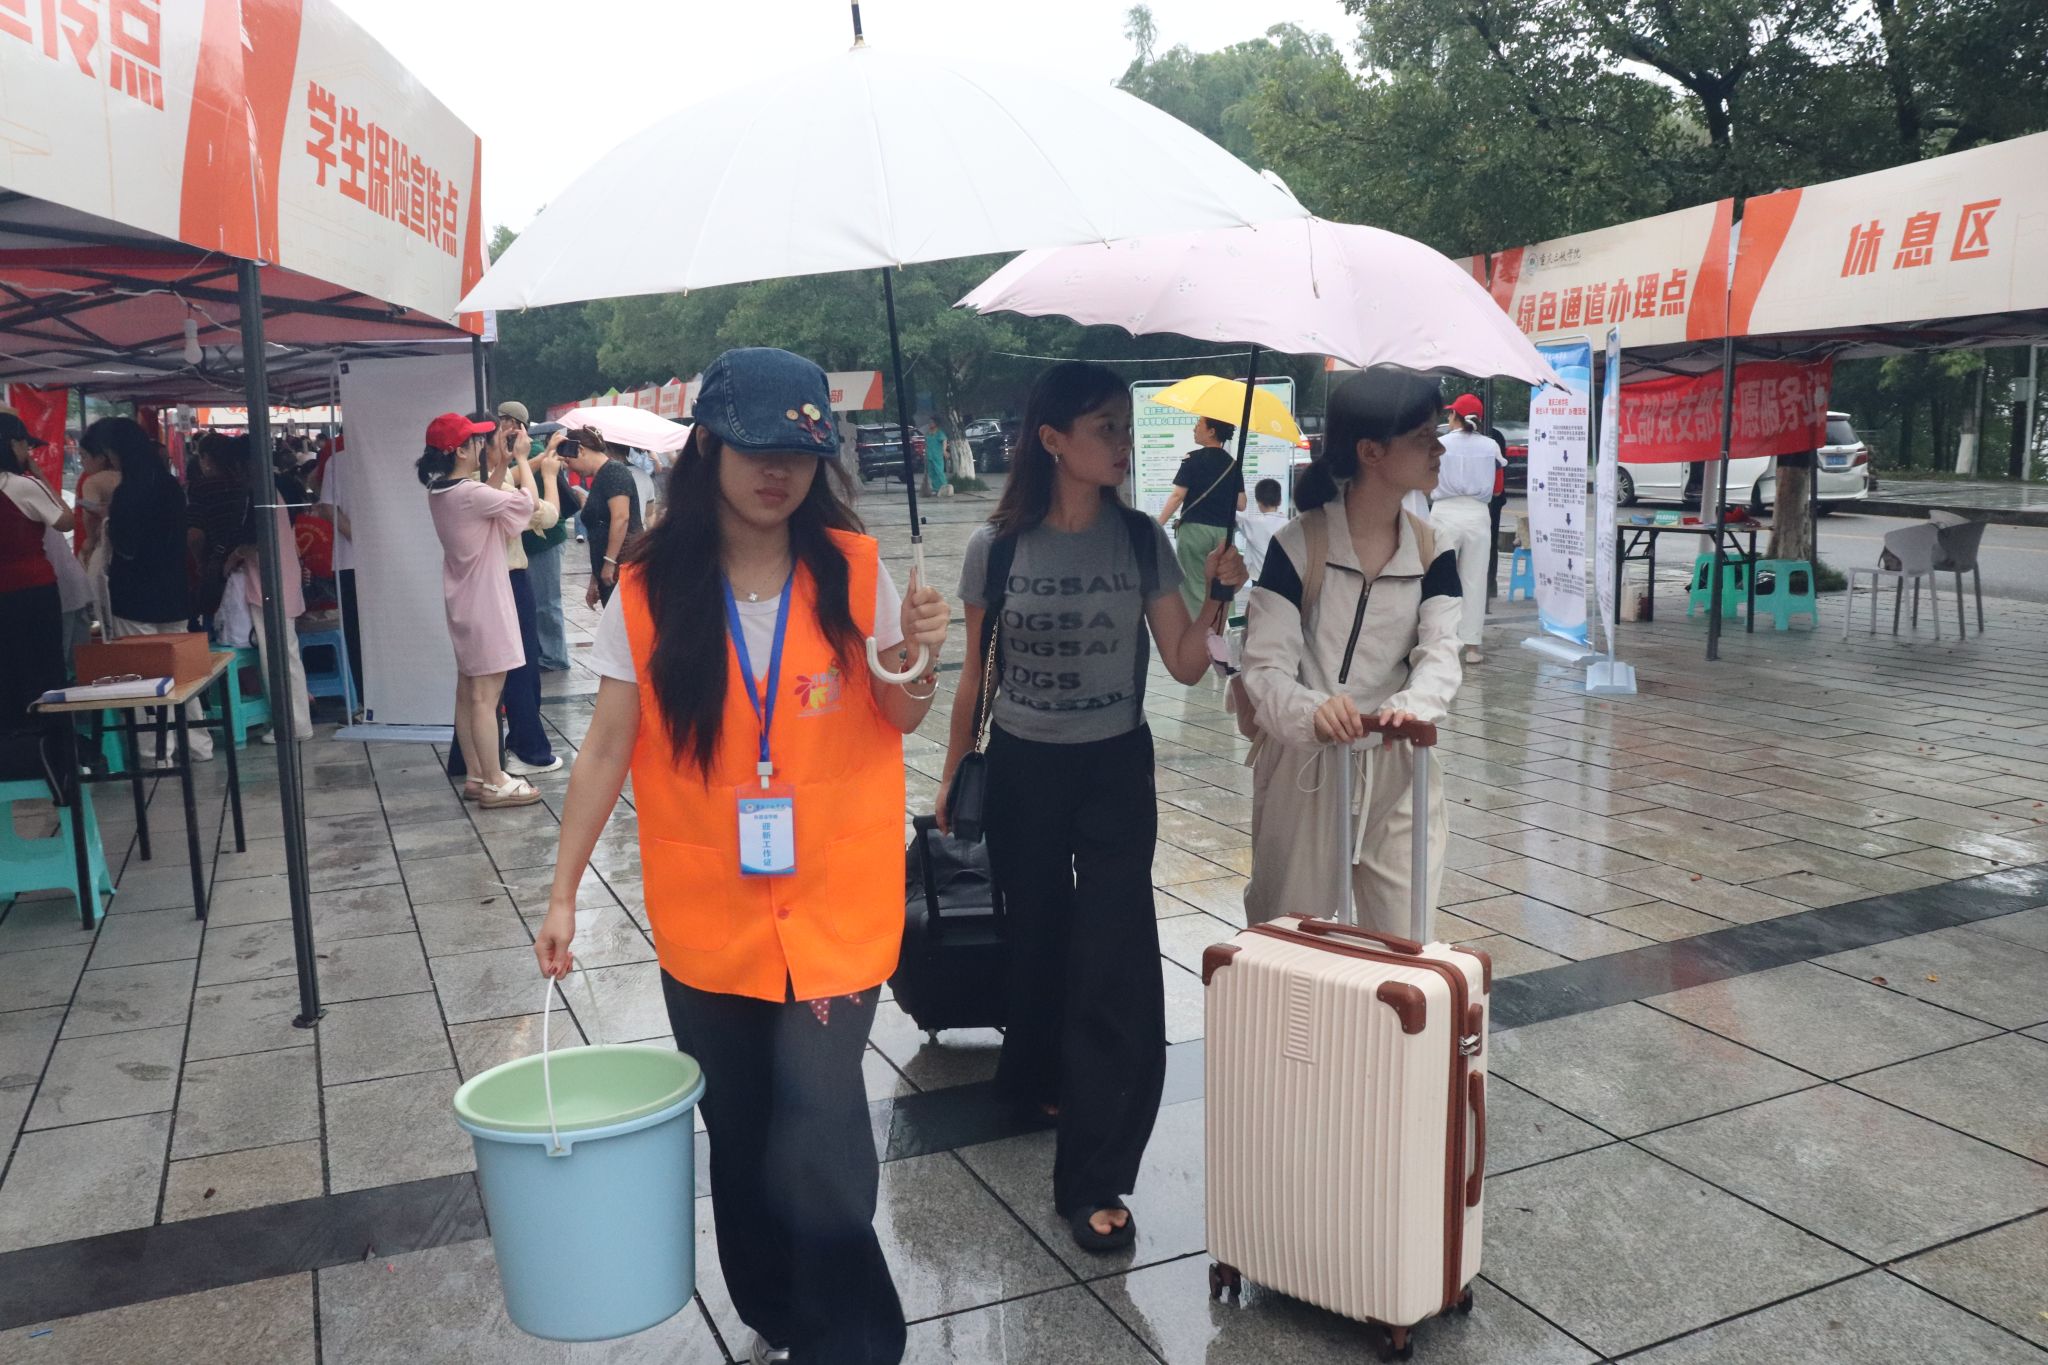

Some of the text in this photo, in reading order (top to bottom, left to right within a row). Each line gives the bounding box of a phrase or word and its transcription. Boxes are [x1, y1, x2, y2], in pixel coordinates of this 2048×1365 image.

[305, 80, 459, 258] 学生保险宣传点
[1841, 199, 2001, 278] 休息区
[1516, 268, 1689, 333] 绿色通道办理点
